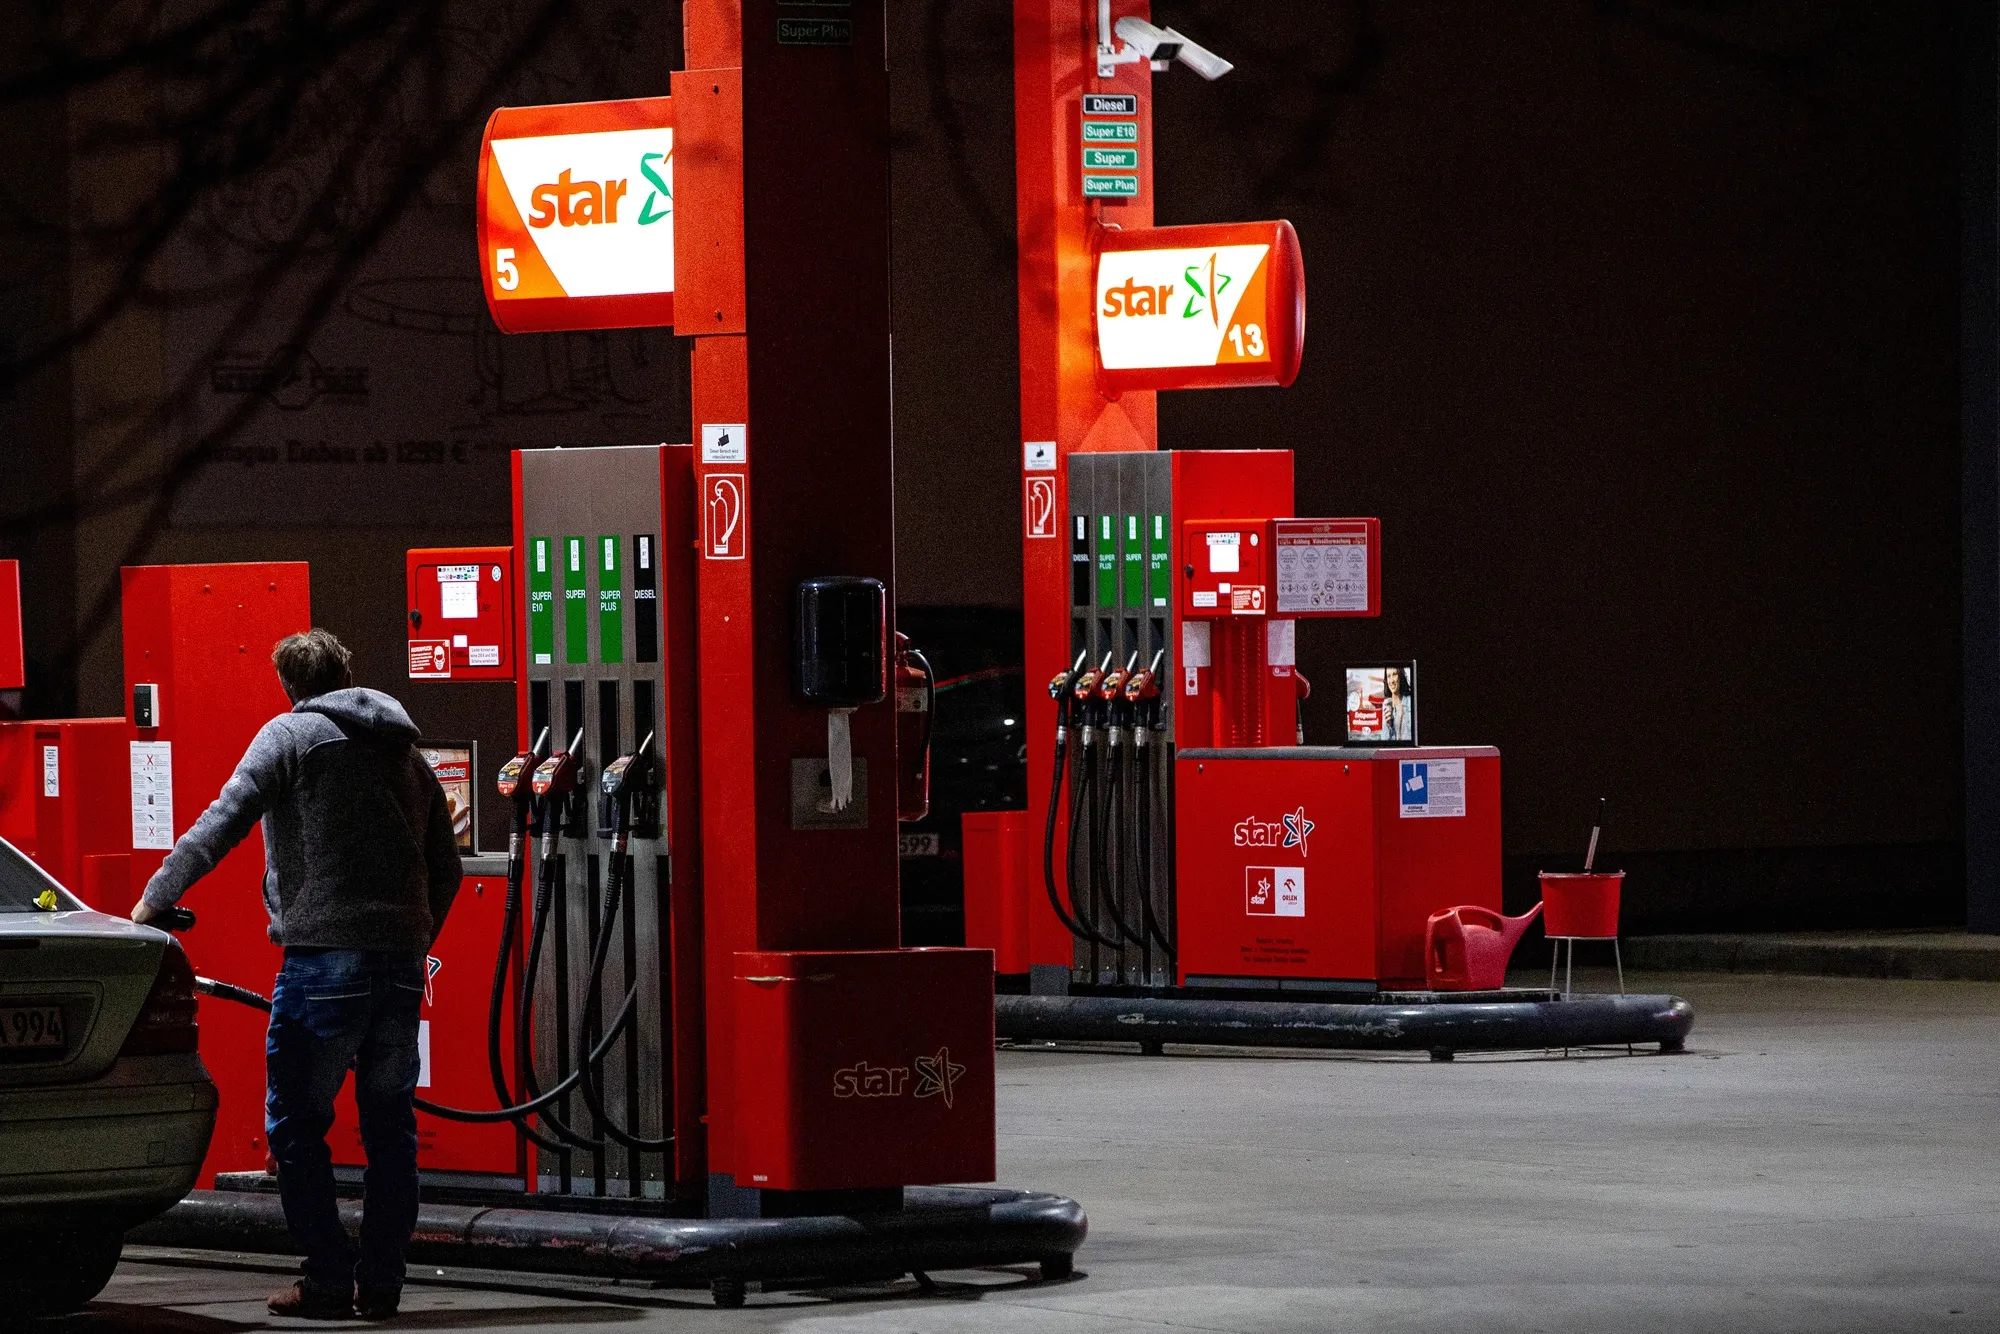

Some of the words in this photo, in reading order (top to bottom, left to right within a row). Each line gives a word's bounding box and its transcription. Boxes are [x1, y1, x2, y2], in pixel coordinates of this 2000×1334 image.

[780, 23, 820, 39] Super
[821, 24, 849, 38] Plus
[1093, 99, 1127, 111] Diesel
[1086, 125, 1115, 139] Super
[1116, 126, 1135, 137] E10
[1094, 151, 1127, 166] Super
[1087, 179, 1113, 192] Super
[1115, 179, 1135, 190] Plus
[529, 168, 627, 228] star
[496, 248, 519, 291] 5
[1103, 276, 1174, 317] star
[1228, 323, 1264, 357] 13
[1073, 553, 1089, 562] DIESEL
[1099, 553, 1115, 562] SUPER
[1125, 553, 1142, 561] SUPER
[1151, 553, 1167, 561] SUPER
[1099, 562, 1112, 570] PLUS
[532, 591, 552, 600] SUPER
[565, 589, 586, 599] SUPER
[600, 590, 621, 600] SUPER
[634, 589, 656, 599] DIESEL
[532, 602, 543, 612] E10
[600, 601, 617, 611] PLUS
[1234, 815, 1281, 847] star
[1251, 895, 1266, 904] star
[13, 1010, 61, 1042] 994
[833, 1061, 910, 1098] star
